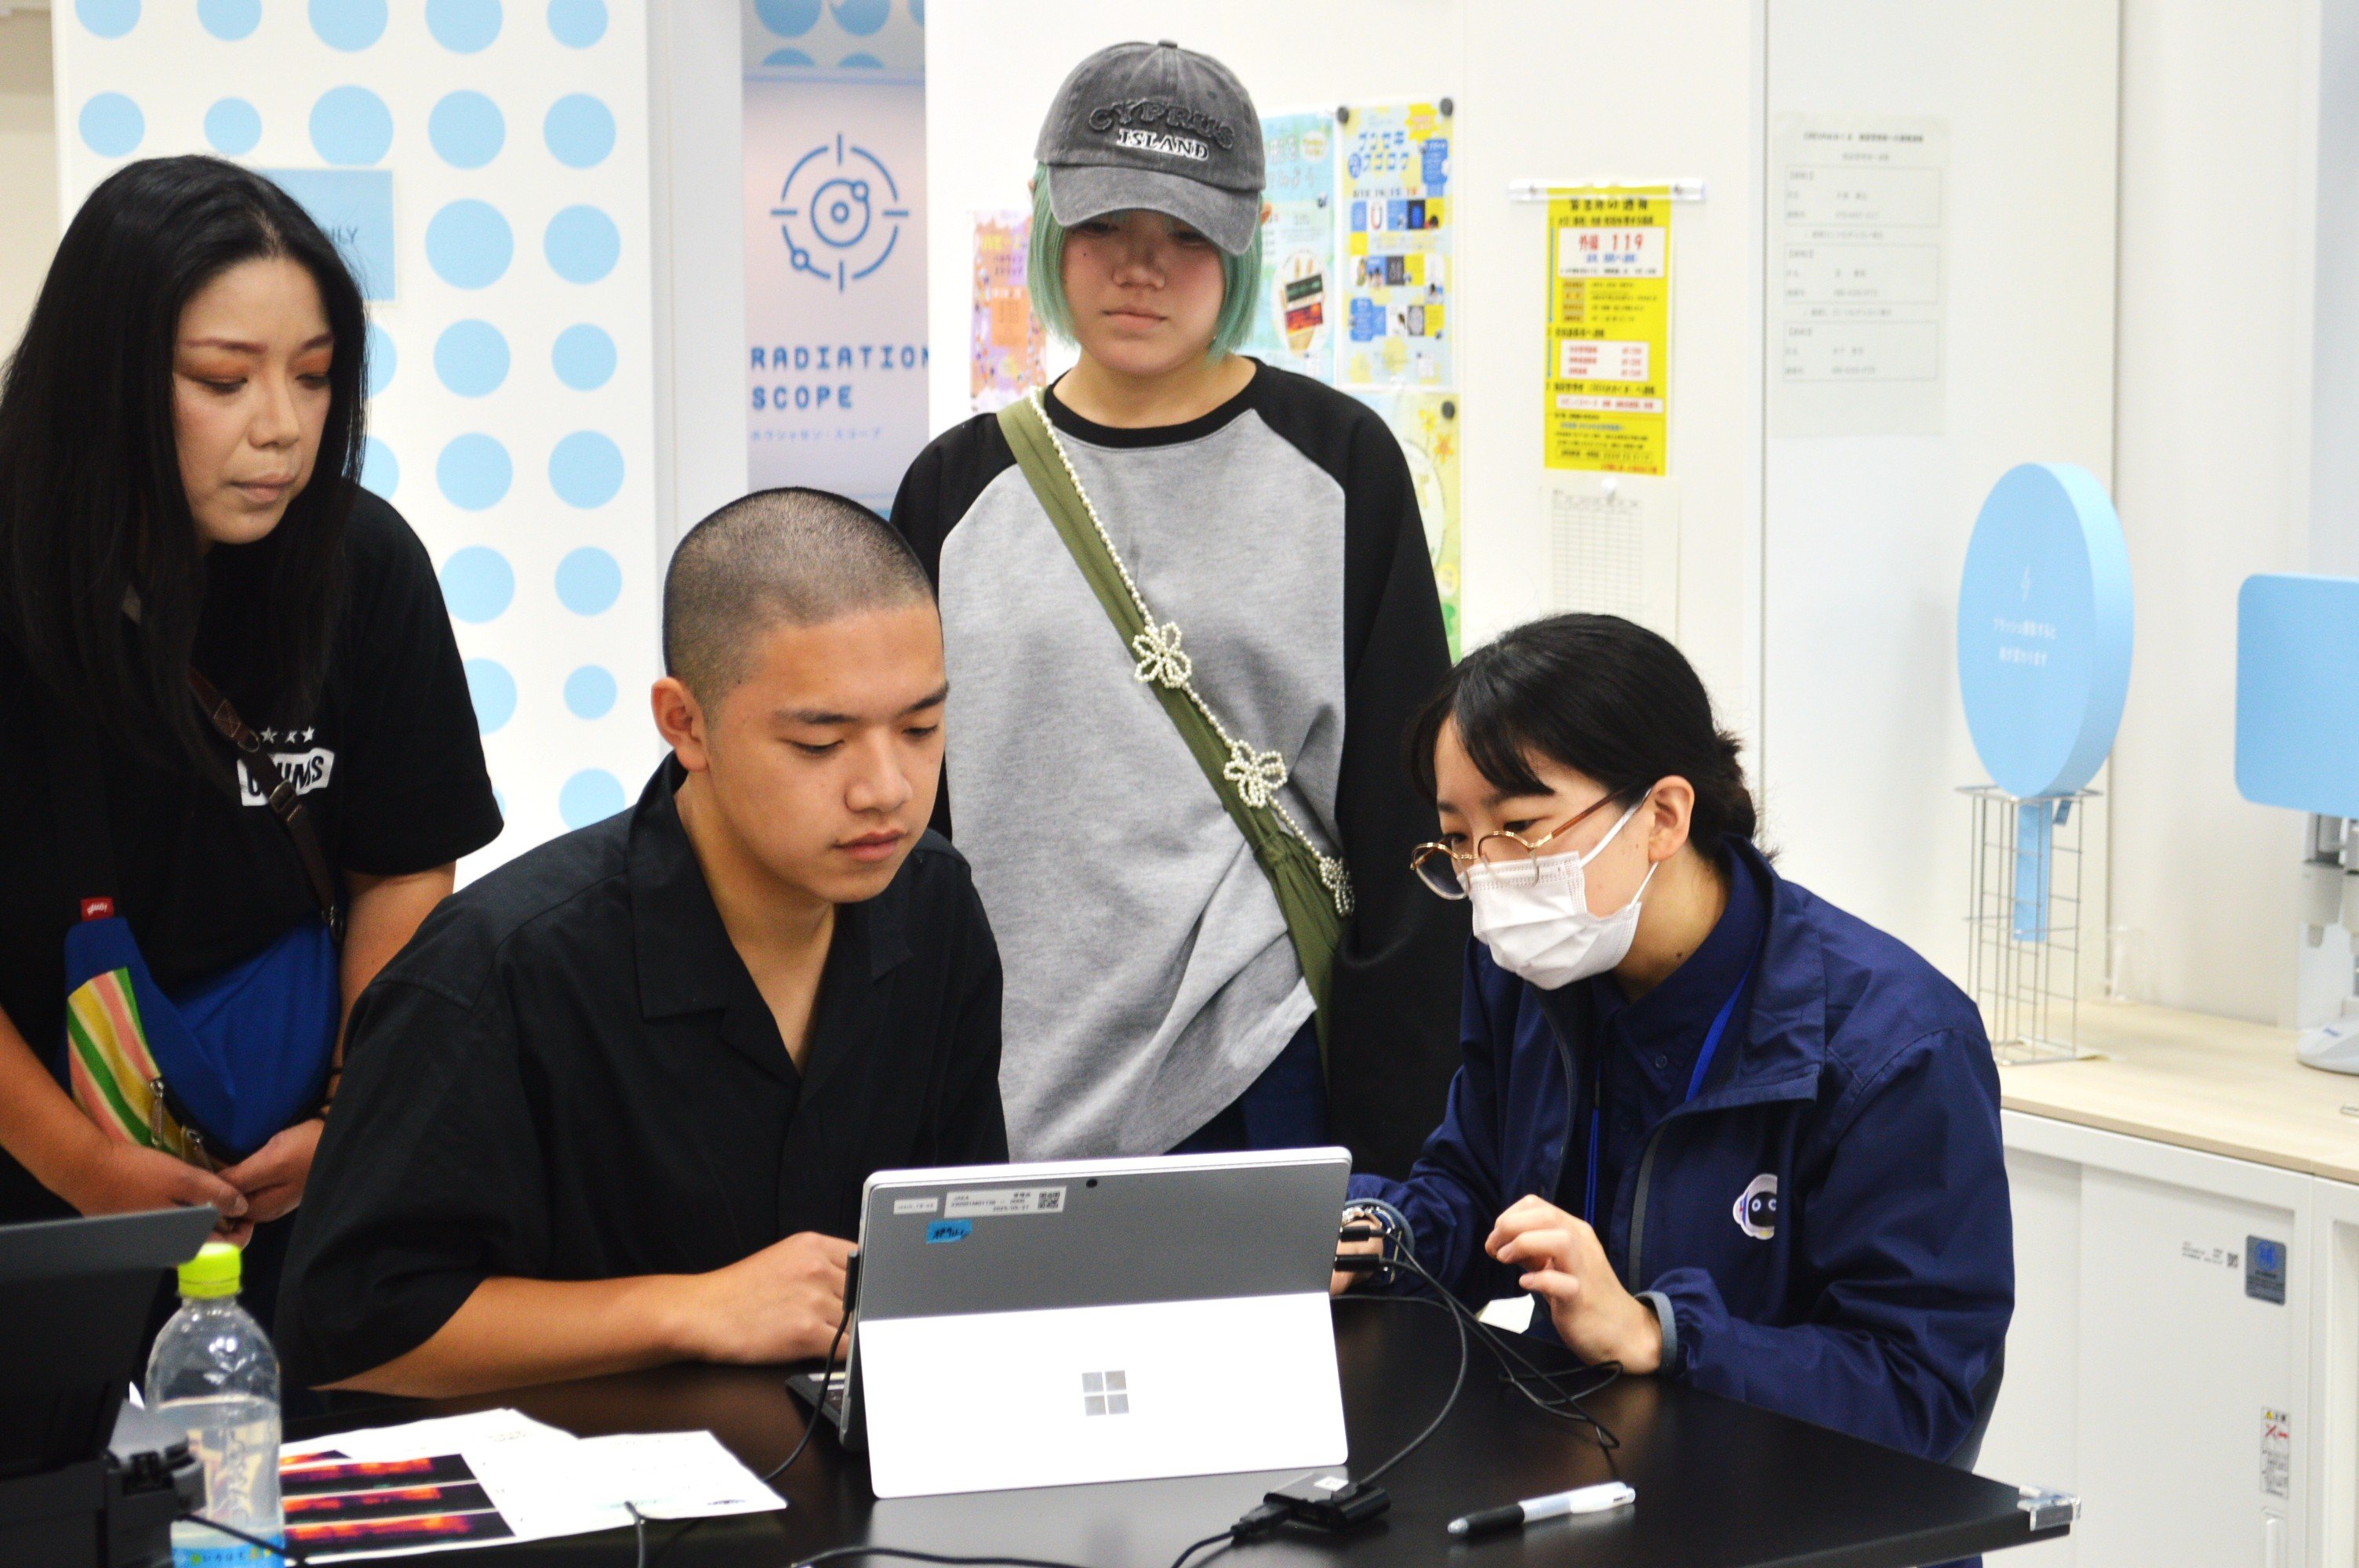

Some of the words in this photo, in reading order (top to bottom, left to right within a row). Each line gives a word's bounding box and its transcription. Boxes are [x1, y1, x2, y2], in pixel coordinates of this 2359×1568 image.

[1088, 97, 1235, 151] CYPRUS
[1117, 128, 1210, 162] ISLAND
[1612, 233, 1644, 250] 119
[751, 385, 852, 410] SCOPE
